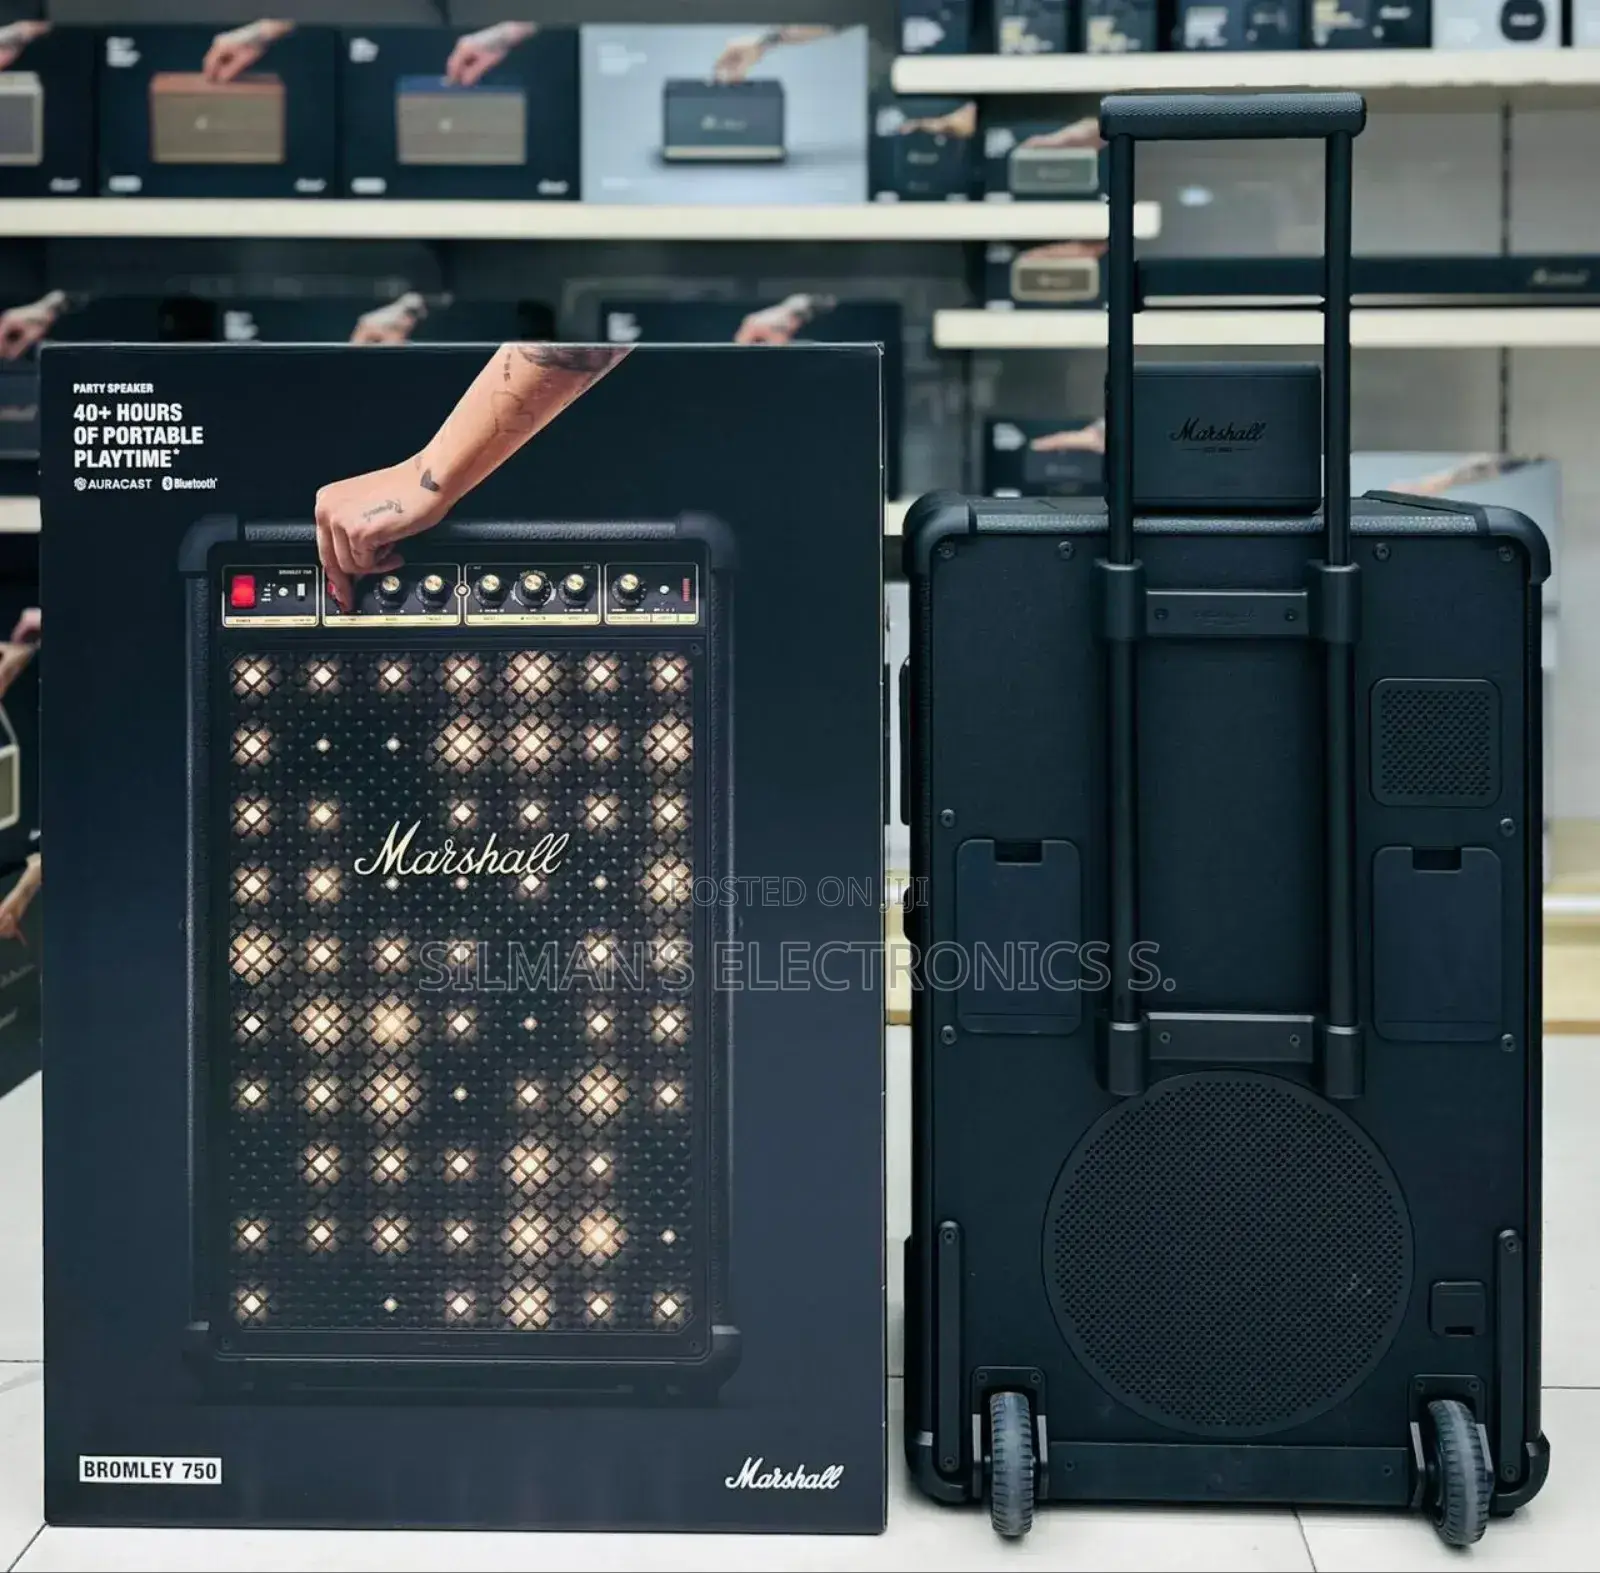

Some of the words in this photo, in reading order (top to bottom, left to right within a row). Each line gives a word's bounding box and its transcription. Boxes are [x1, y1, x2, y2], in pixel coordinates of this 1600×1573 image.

[73, 383, 105, 394] PARTY
[107, 383, 154, 394] SPEAKER
[73, 403, 111, 422] 40+
[116, 403, 183, 422] HOURS
[74, 426, 98, 445] OF
[103, 426, 204, 445] PORTABLE
[1169, 417, 1267, 442] Marshall
[88, 479, 152, 490] AURACAST
[354, 820, 570, 876] Marshall
[84, 1461, 174, 1479] BROMLEY
[182, 1463, 217, 1480] 750
[724, 1456, 844, 1490] Marshall
